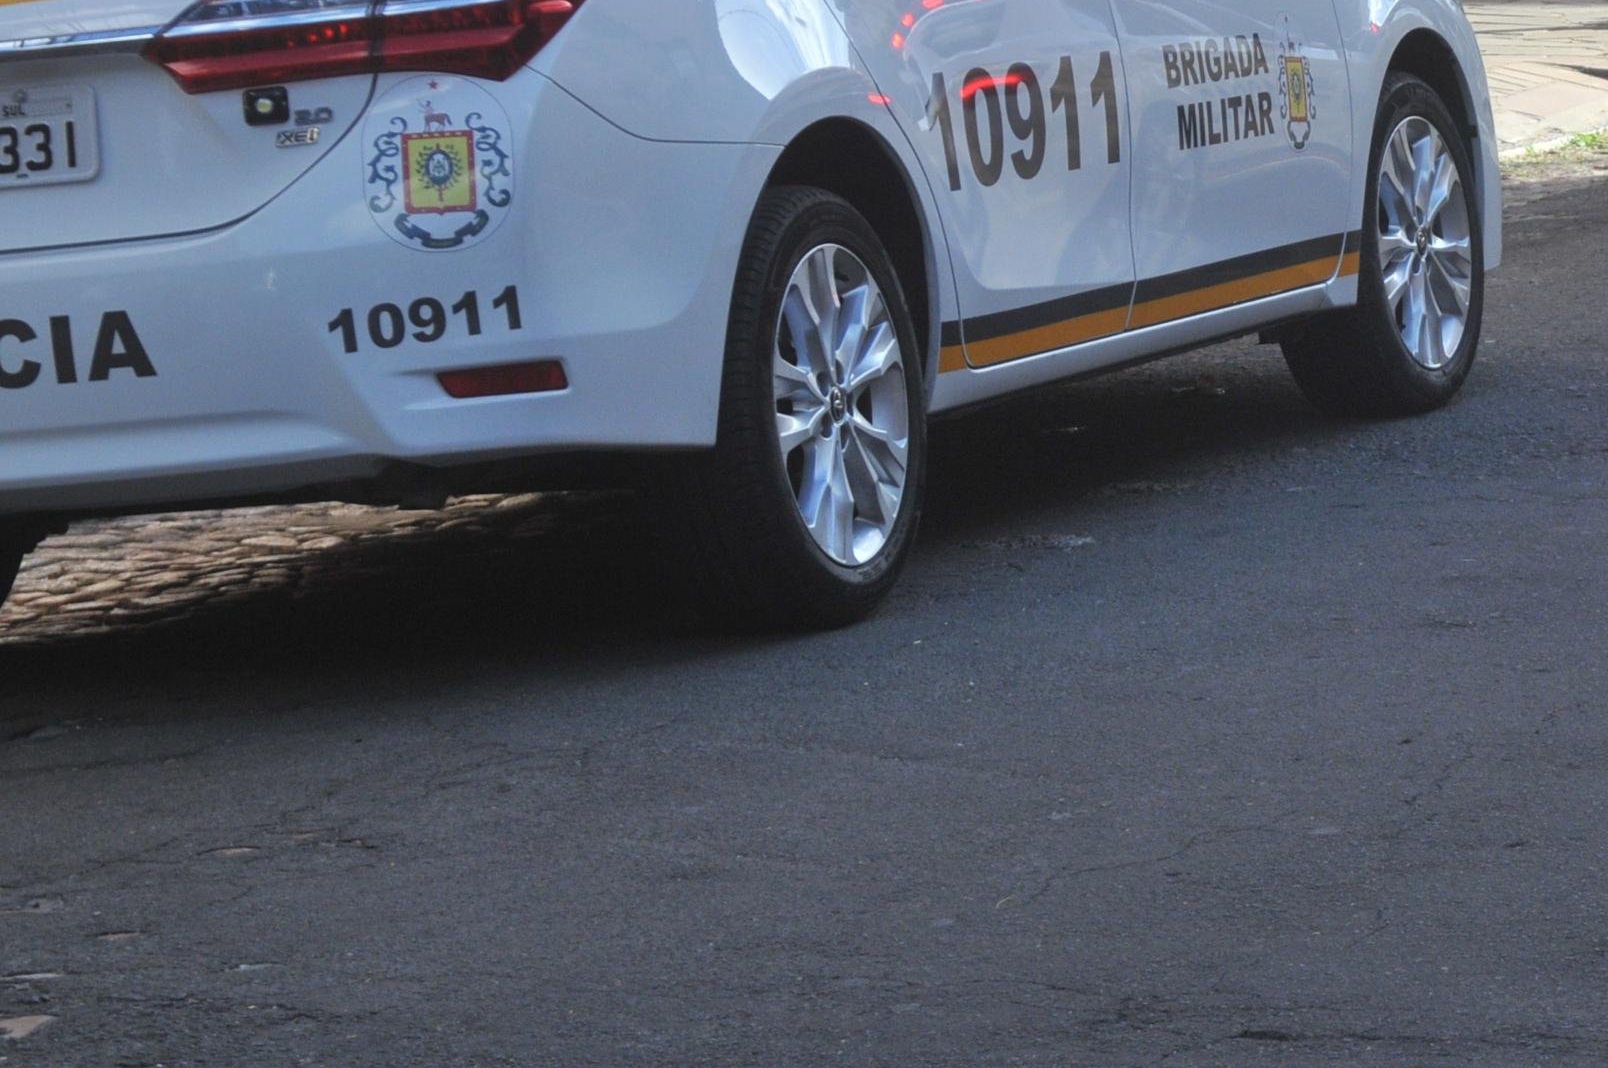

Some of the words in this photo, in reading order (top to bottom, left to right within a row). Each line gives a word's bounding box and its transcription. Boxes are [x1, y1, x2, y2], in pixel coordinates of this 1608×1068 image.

[1161, 33, 1270, 88] BRIGADA
[923, 51, 1121, 191] 10911
[1177, 92, 1275, 151] MILITAR
[328, 285, 523, 353] 10911
